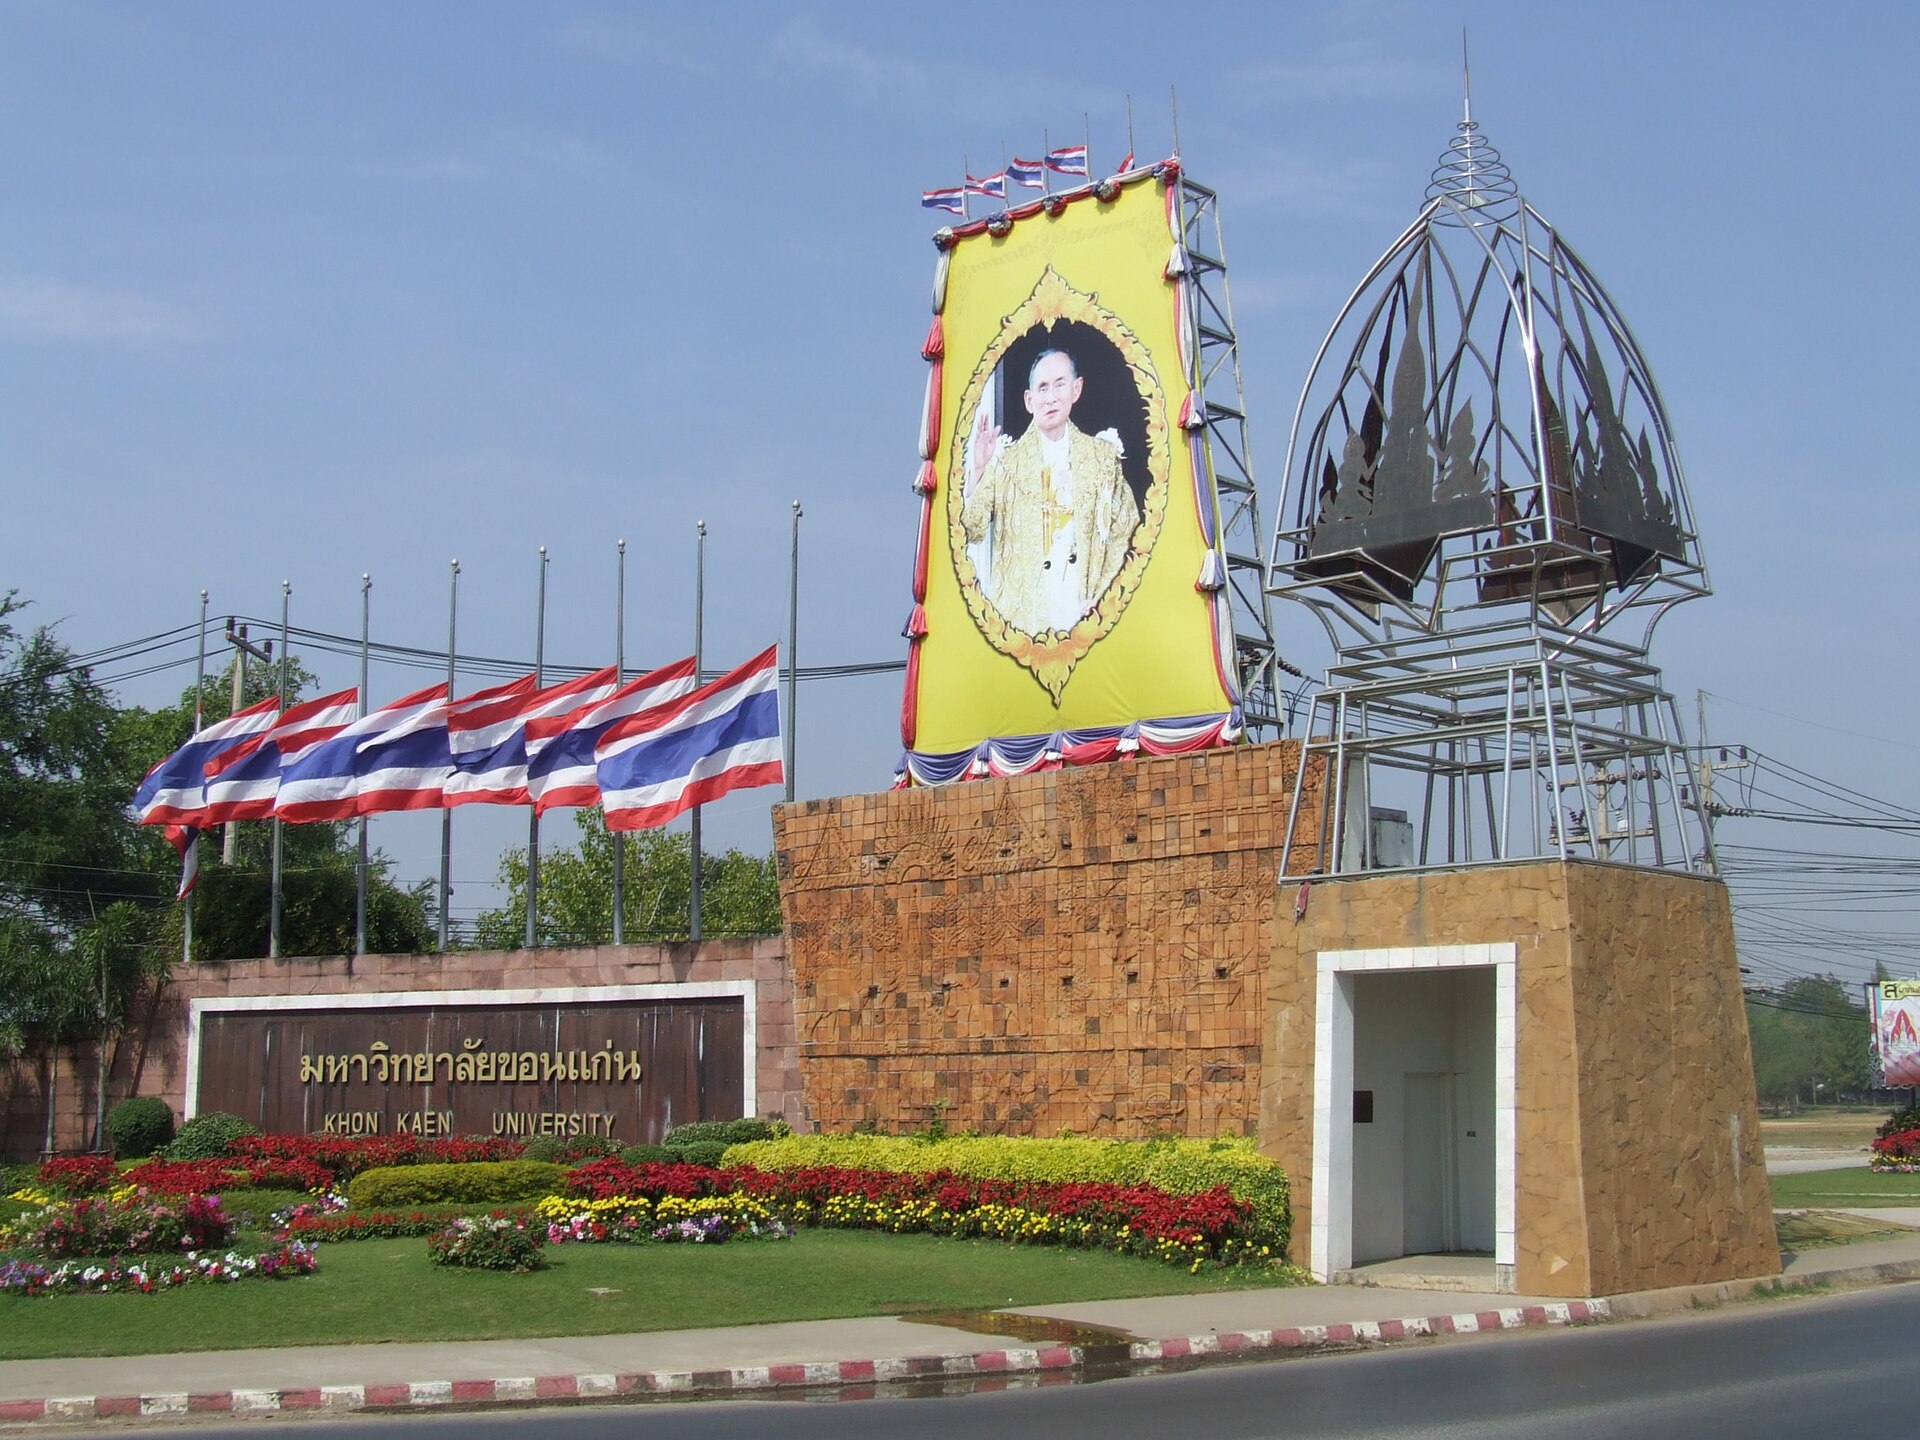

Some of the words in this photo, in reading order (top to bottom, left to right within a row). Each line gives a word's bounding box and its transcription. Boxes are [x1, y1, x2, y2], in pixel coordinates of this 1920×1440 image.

[300, 1038, 642, 1083] มหาวิทยาลัยขอนแก่น
[324, 1111, 378, 1133] KHON
[397, 1111, 451, 1133] KAEN
[492, 1112, 614, 1137] UNIVERSITY
